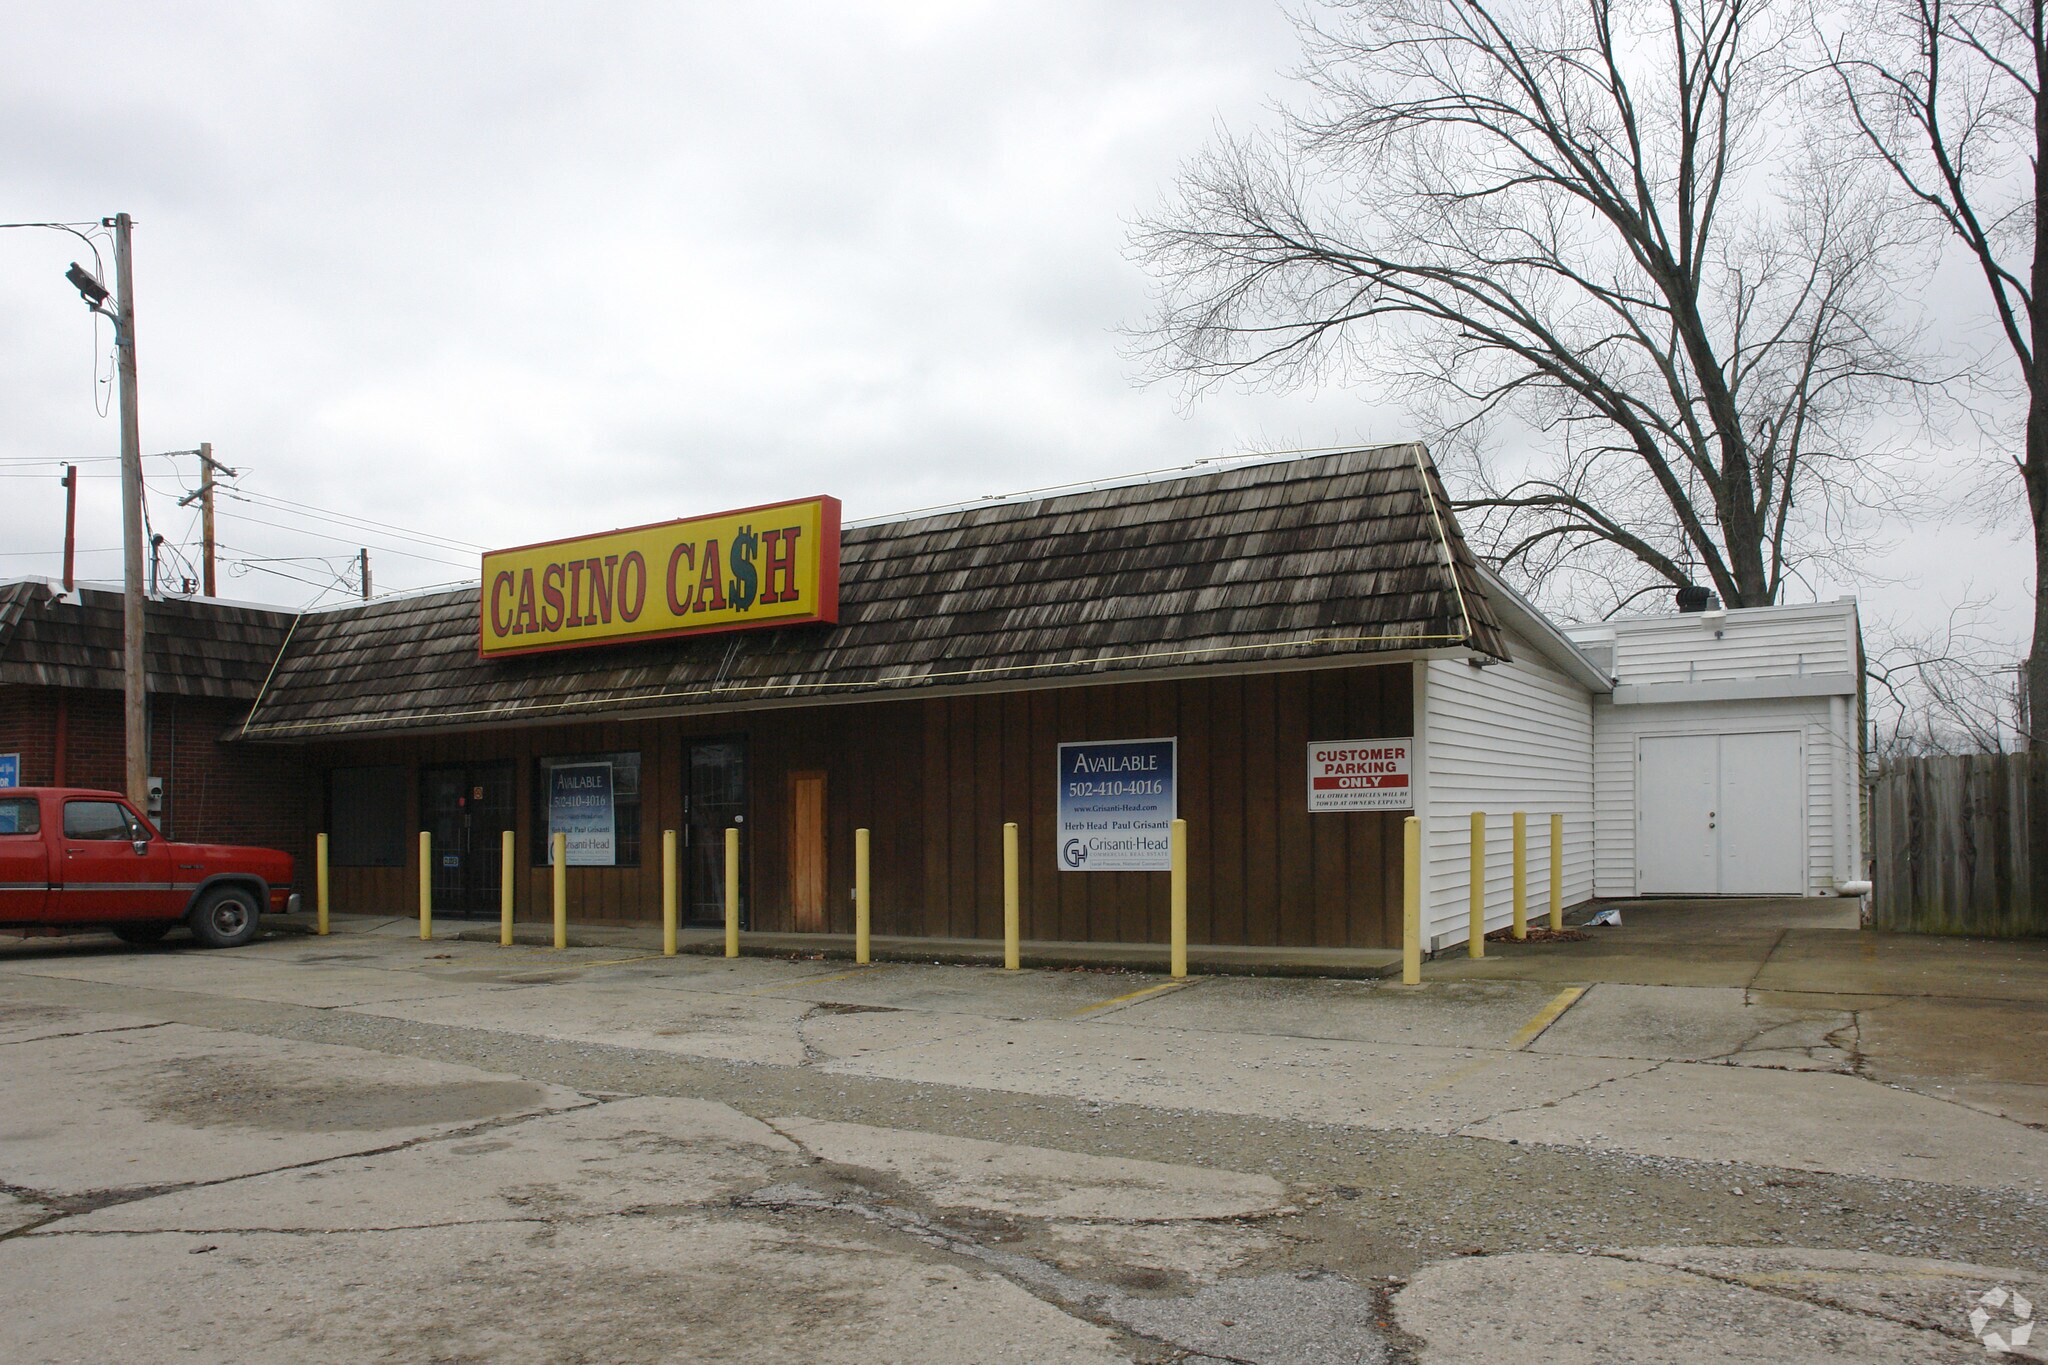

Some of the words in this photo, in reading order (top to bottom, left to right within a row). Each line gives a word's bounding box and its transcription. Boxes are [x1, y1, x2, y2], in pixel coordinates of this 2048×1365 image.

[491, 551, 646, 638] CASINO
[666, 525, 801, 616] CA$H
[1316, 748, 1405, 762] CUSTOMER
[1073, 753, 1158, 773] AVAILABLE
[1324, 761, 1397, 775] PARKING
[557, 774, 603, 790] AVAILABLE
[1069, 780, 1162, 797] 502-410-4016
[1338, 776, 1382, 788] ONLY
[1074, 804, 1158, 813] www.Grisanti-Head.com
[1065, 821, 1085, 830] Herb
[1086, 821, 1108, 830] Head
[1112, 821, 1131, 830] Paul
[1133, 820, 1169, 830] Grisanti
[1089, 836, 1168, 850] Grisanti-Head
